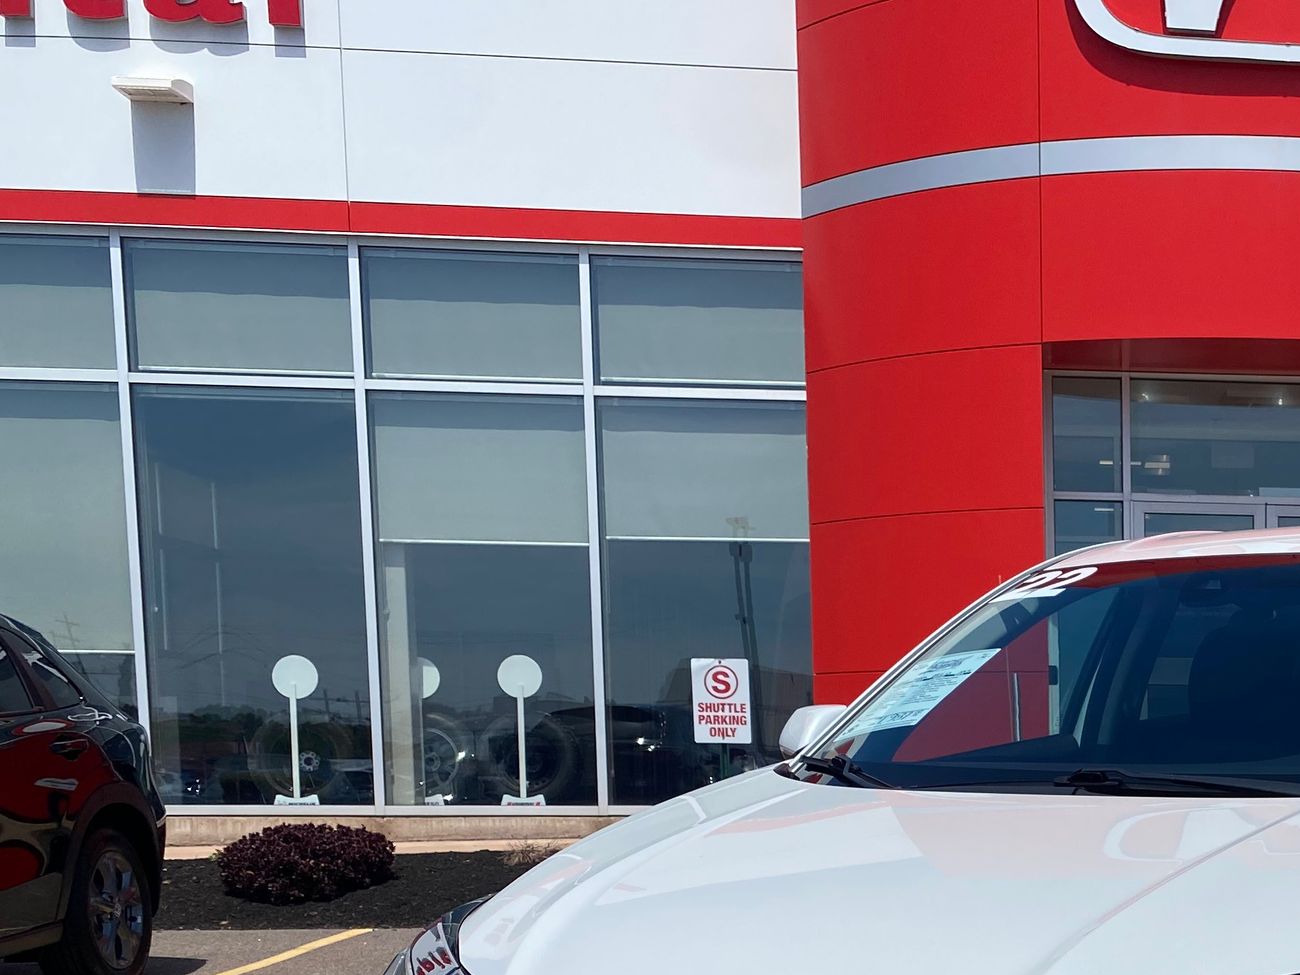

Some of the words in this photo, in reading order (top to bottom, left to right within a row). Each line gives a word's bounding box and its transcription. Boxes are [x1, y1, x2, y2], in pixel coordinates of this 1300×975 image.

[711, 671, 731, 694] S
[697, 702, 747, 714] SHUTTLE
[698, 715, 747, 726] PARKING
[709, 727, 737, 738] ONLY
